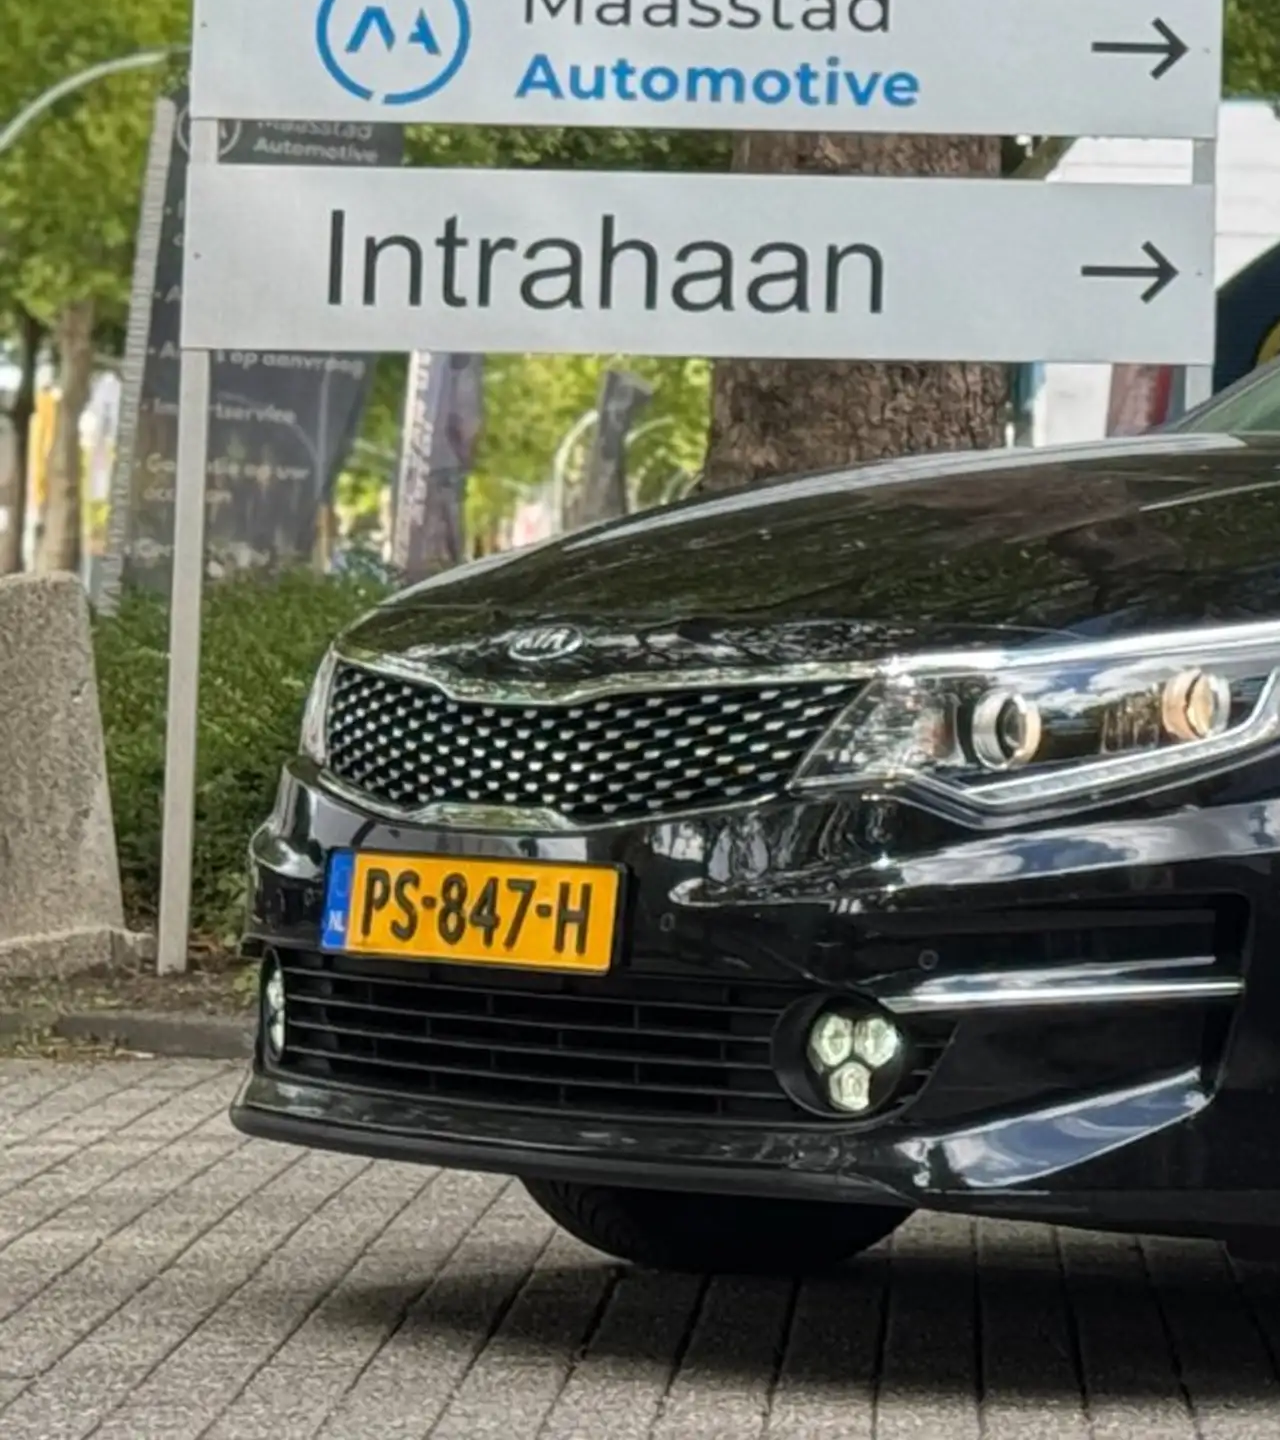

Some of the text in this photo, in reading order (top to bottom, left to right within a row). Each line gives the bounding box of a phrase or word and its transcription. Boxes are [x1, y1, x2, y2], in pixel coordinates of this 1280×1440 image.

[515, 52, 921, 110] Automotive
[327, 209, 883, 314] Intrahaan
[328, 910, 345, 934] NL
[360, 867, 593, 956] PS-847-H
